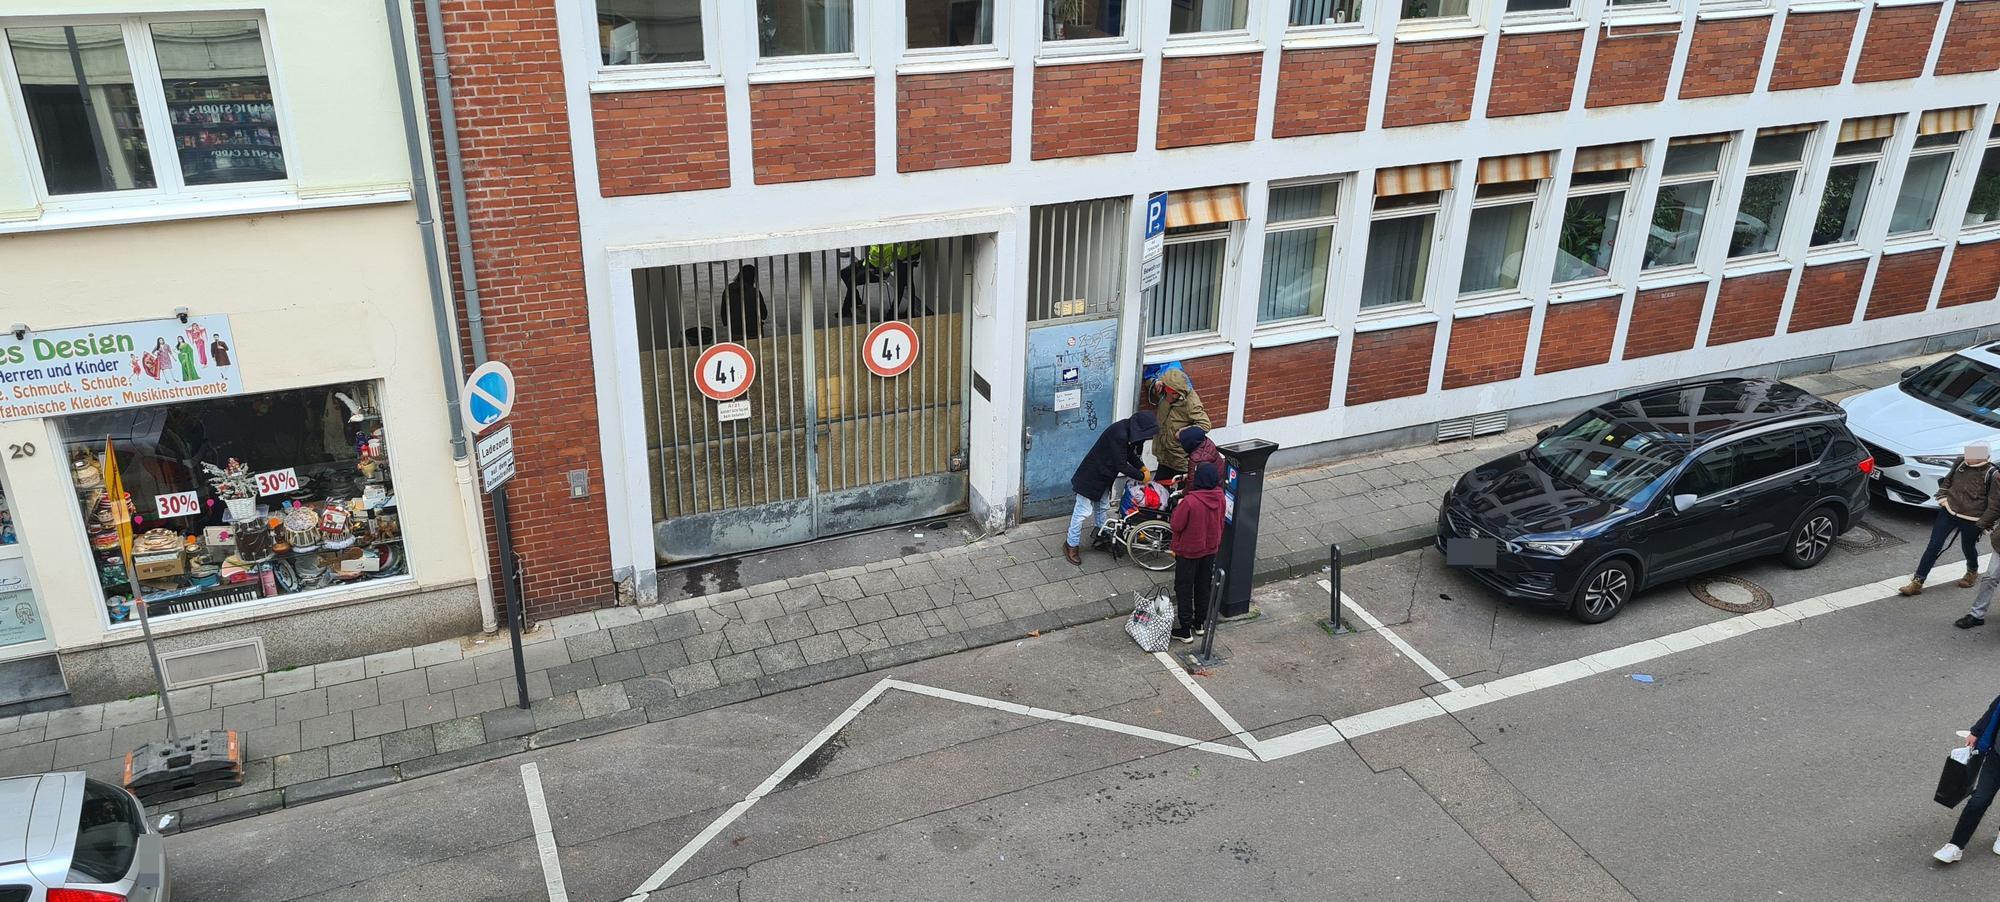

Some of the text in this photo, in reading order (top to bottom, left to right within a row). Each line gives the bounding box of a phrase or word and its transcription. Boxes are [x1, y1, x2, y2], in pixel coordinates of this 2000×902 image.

[1148, 201, 1161, 233] P
[33, 332, 135, 361] Design
[47, 363, 72, 378] und
[75, 359, 119, 375] Kinder
[122, 382, 228, 404] Musikinstrumente
[9, 441, 36, 460] 20
[482, 436, 509, 458] Ladezone
[258, 471, 296, 493] 30%
[158, 494, 198, 516] 30%
